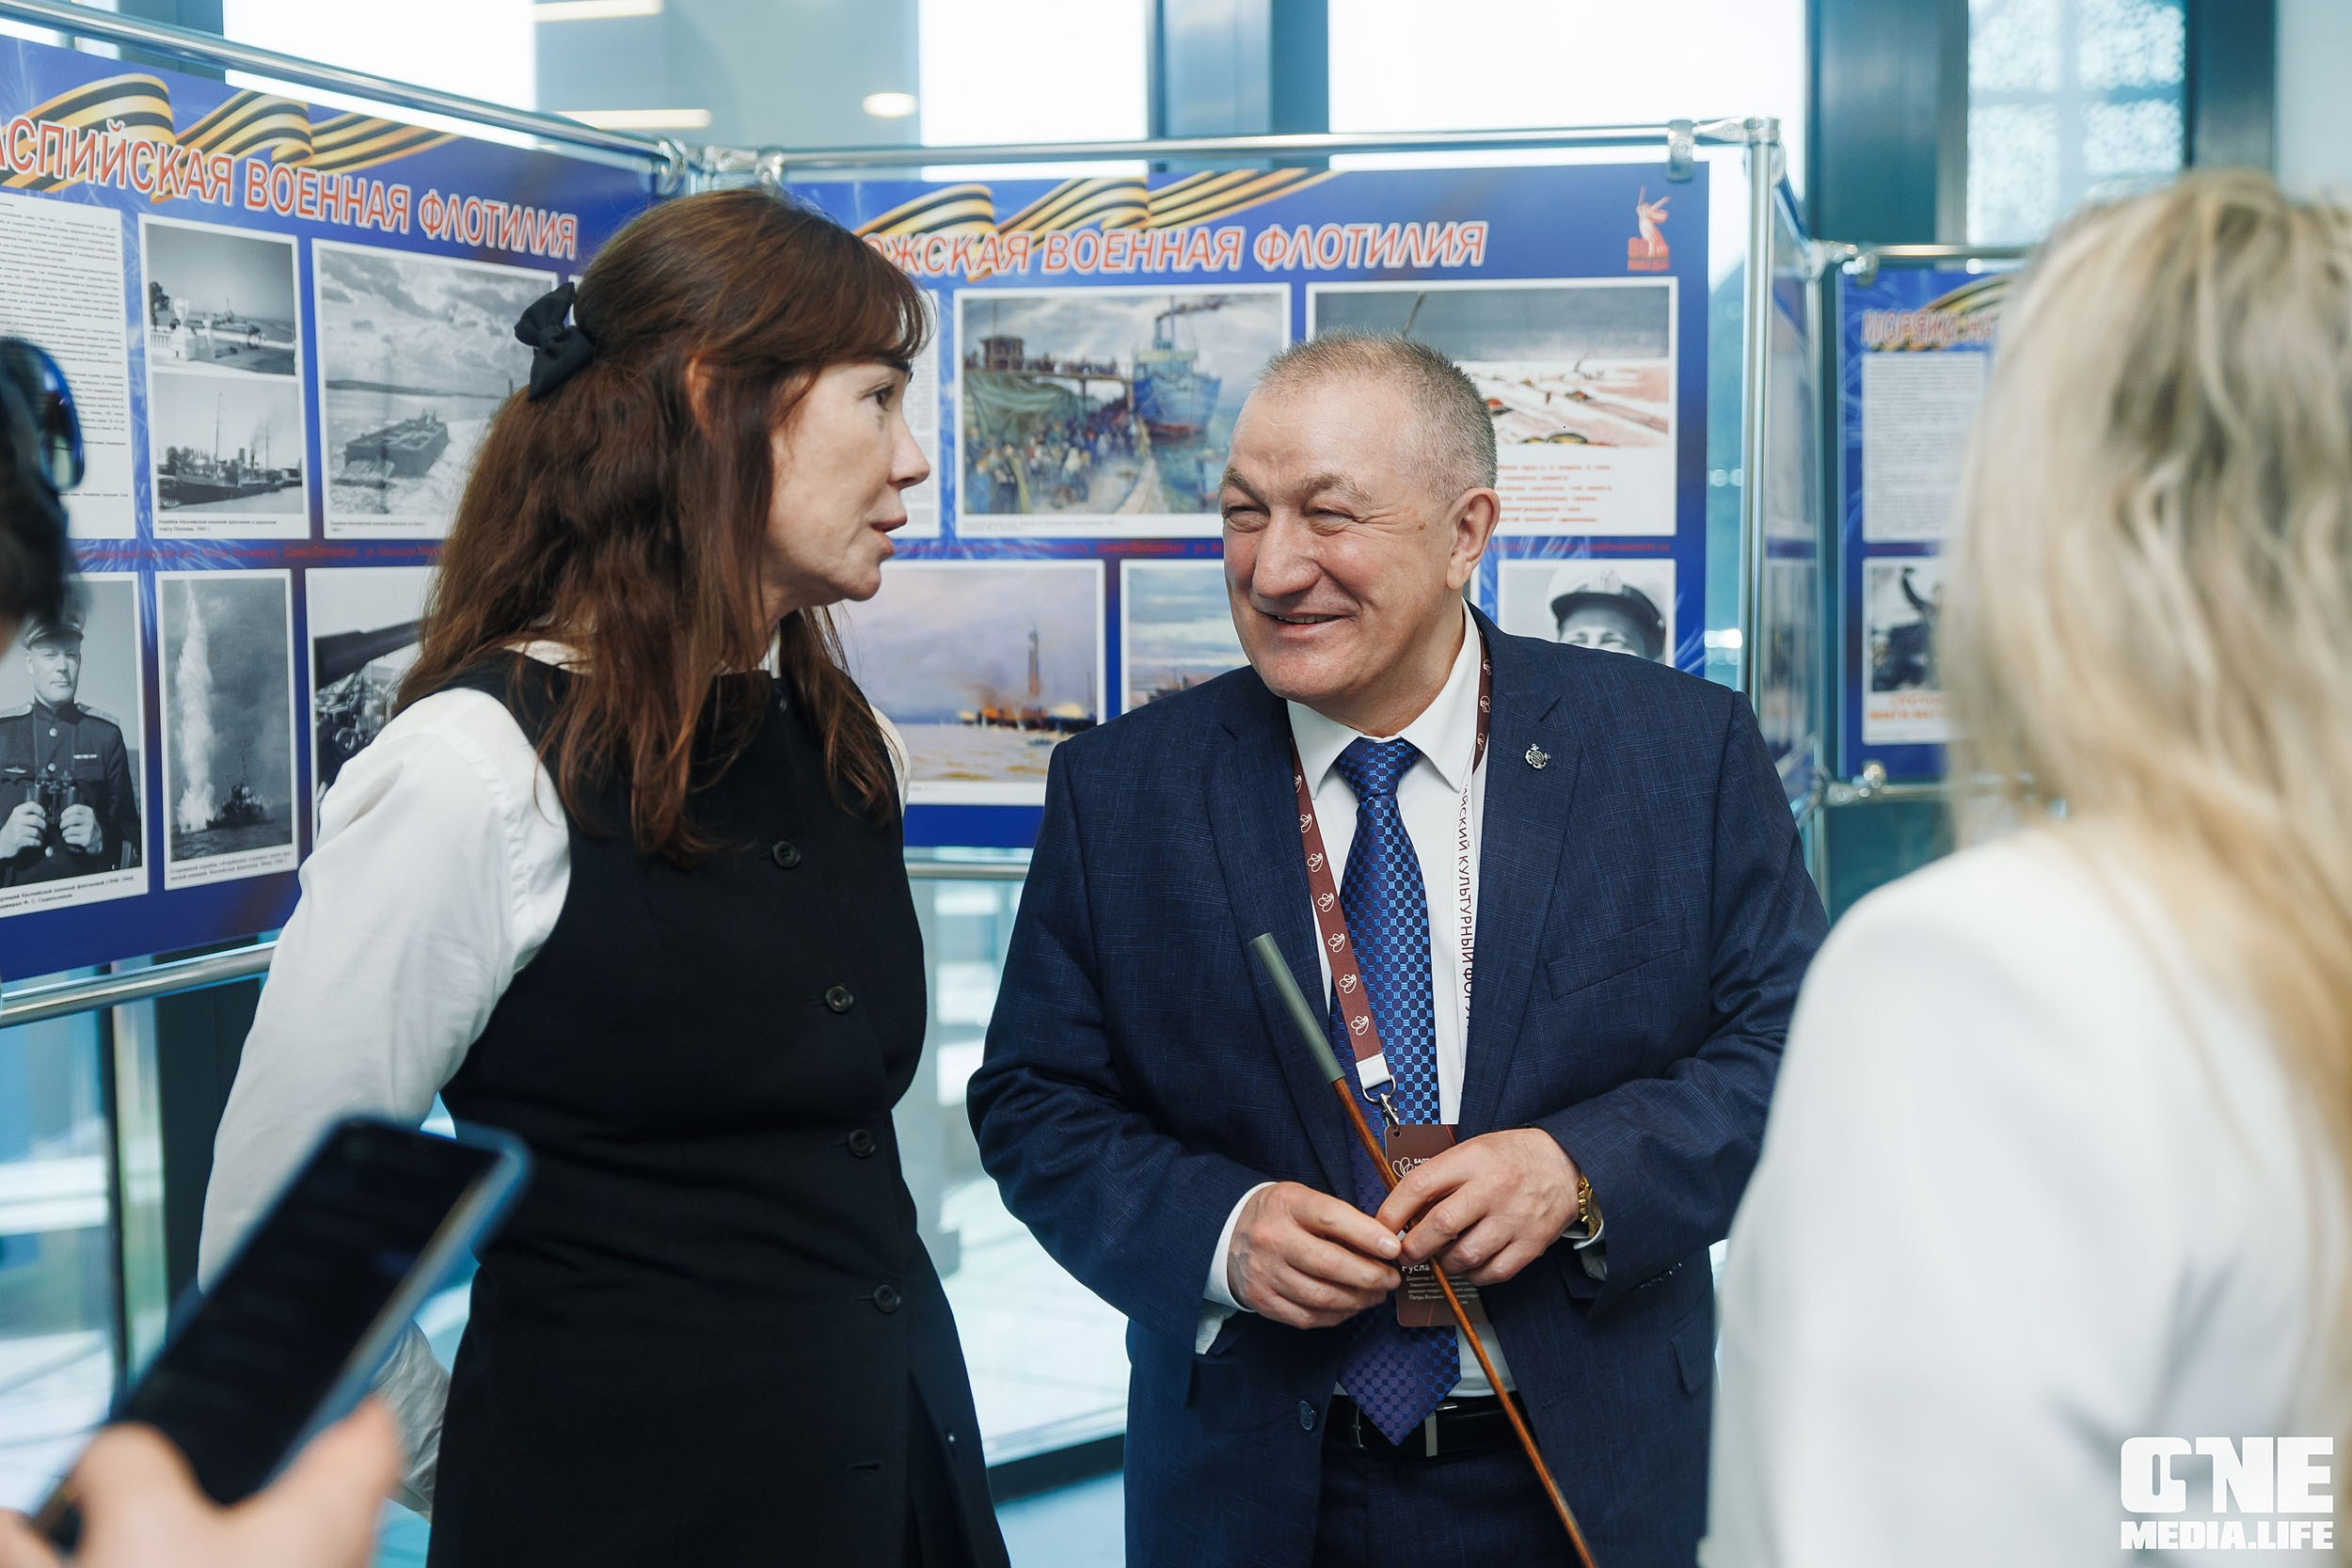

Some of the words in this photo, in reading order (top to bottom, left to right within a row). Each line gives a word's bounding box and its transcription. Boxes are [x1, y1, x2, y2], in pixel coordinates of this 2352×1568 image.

[0, 117, 235, 205] СПИЙСКАЯ
[246, 158, 410, 233] ВОЕННАЯ
[420, 190, 578, 260] ФЛОТИЛИЯ
[1042, 227, 1244, 273] ВОЕННАЯ
[1254, 222, 1487, 269] ФЛОТИЛИЯ
[1402, 1264, 1430, 1274] Русла
